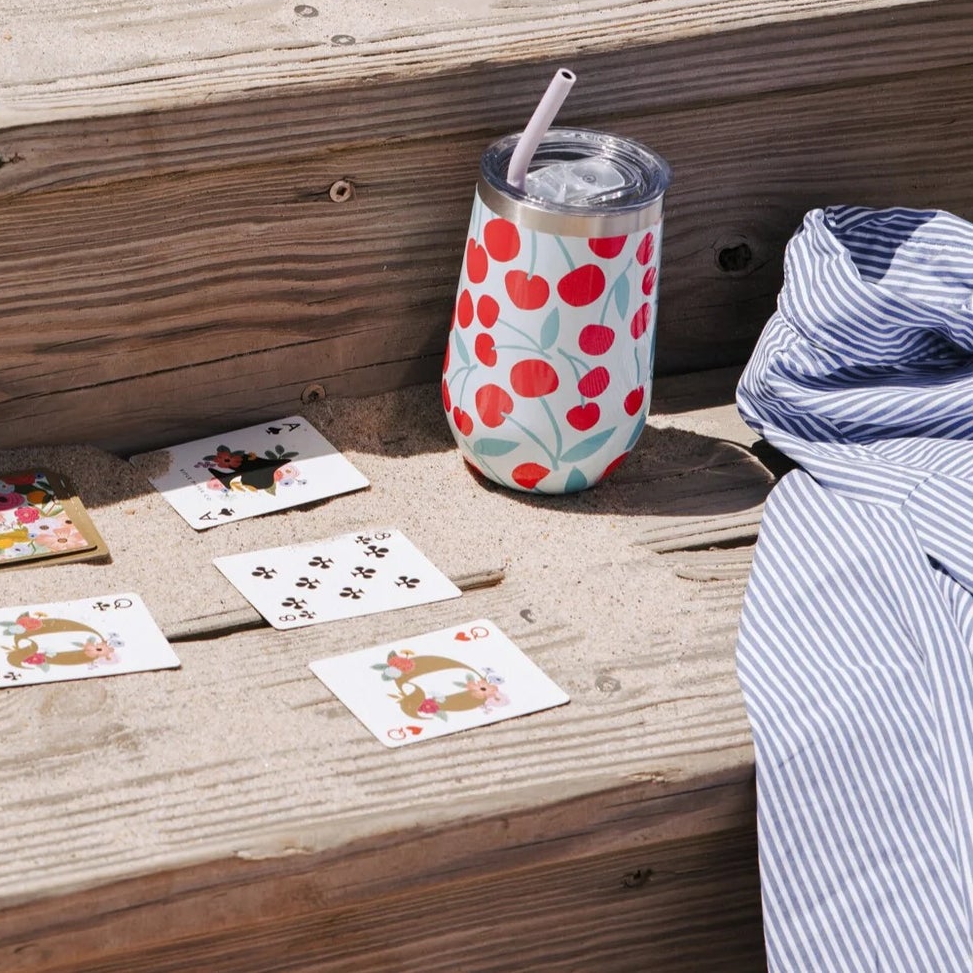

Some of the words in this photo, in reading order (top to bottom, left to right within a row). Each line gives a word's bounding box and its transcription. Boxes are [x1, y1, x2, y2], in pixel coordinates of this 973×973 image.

[282, 423, 301, 432] A
[198, 511, 218, 520] A
[374, 532, 391, 541] 8
[113, 598, 133, 610] Q
[278, 614, 297, 622] 8
[470, 626, 490, 640] Q
[387, 727, 407, 741] Q
